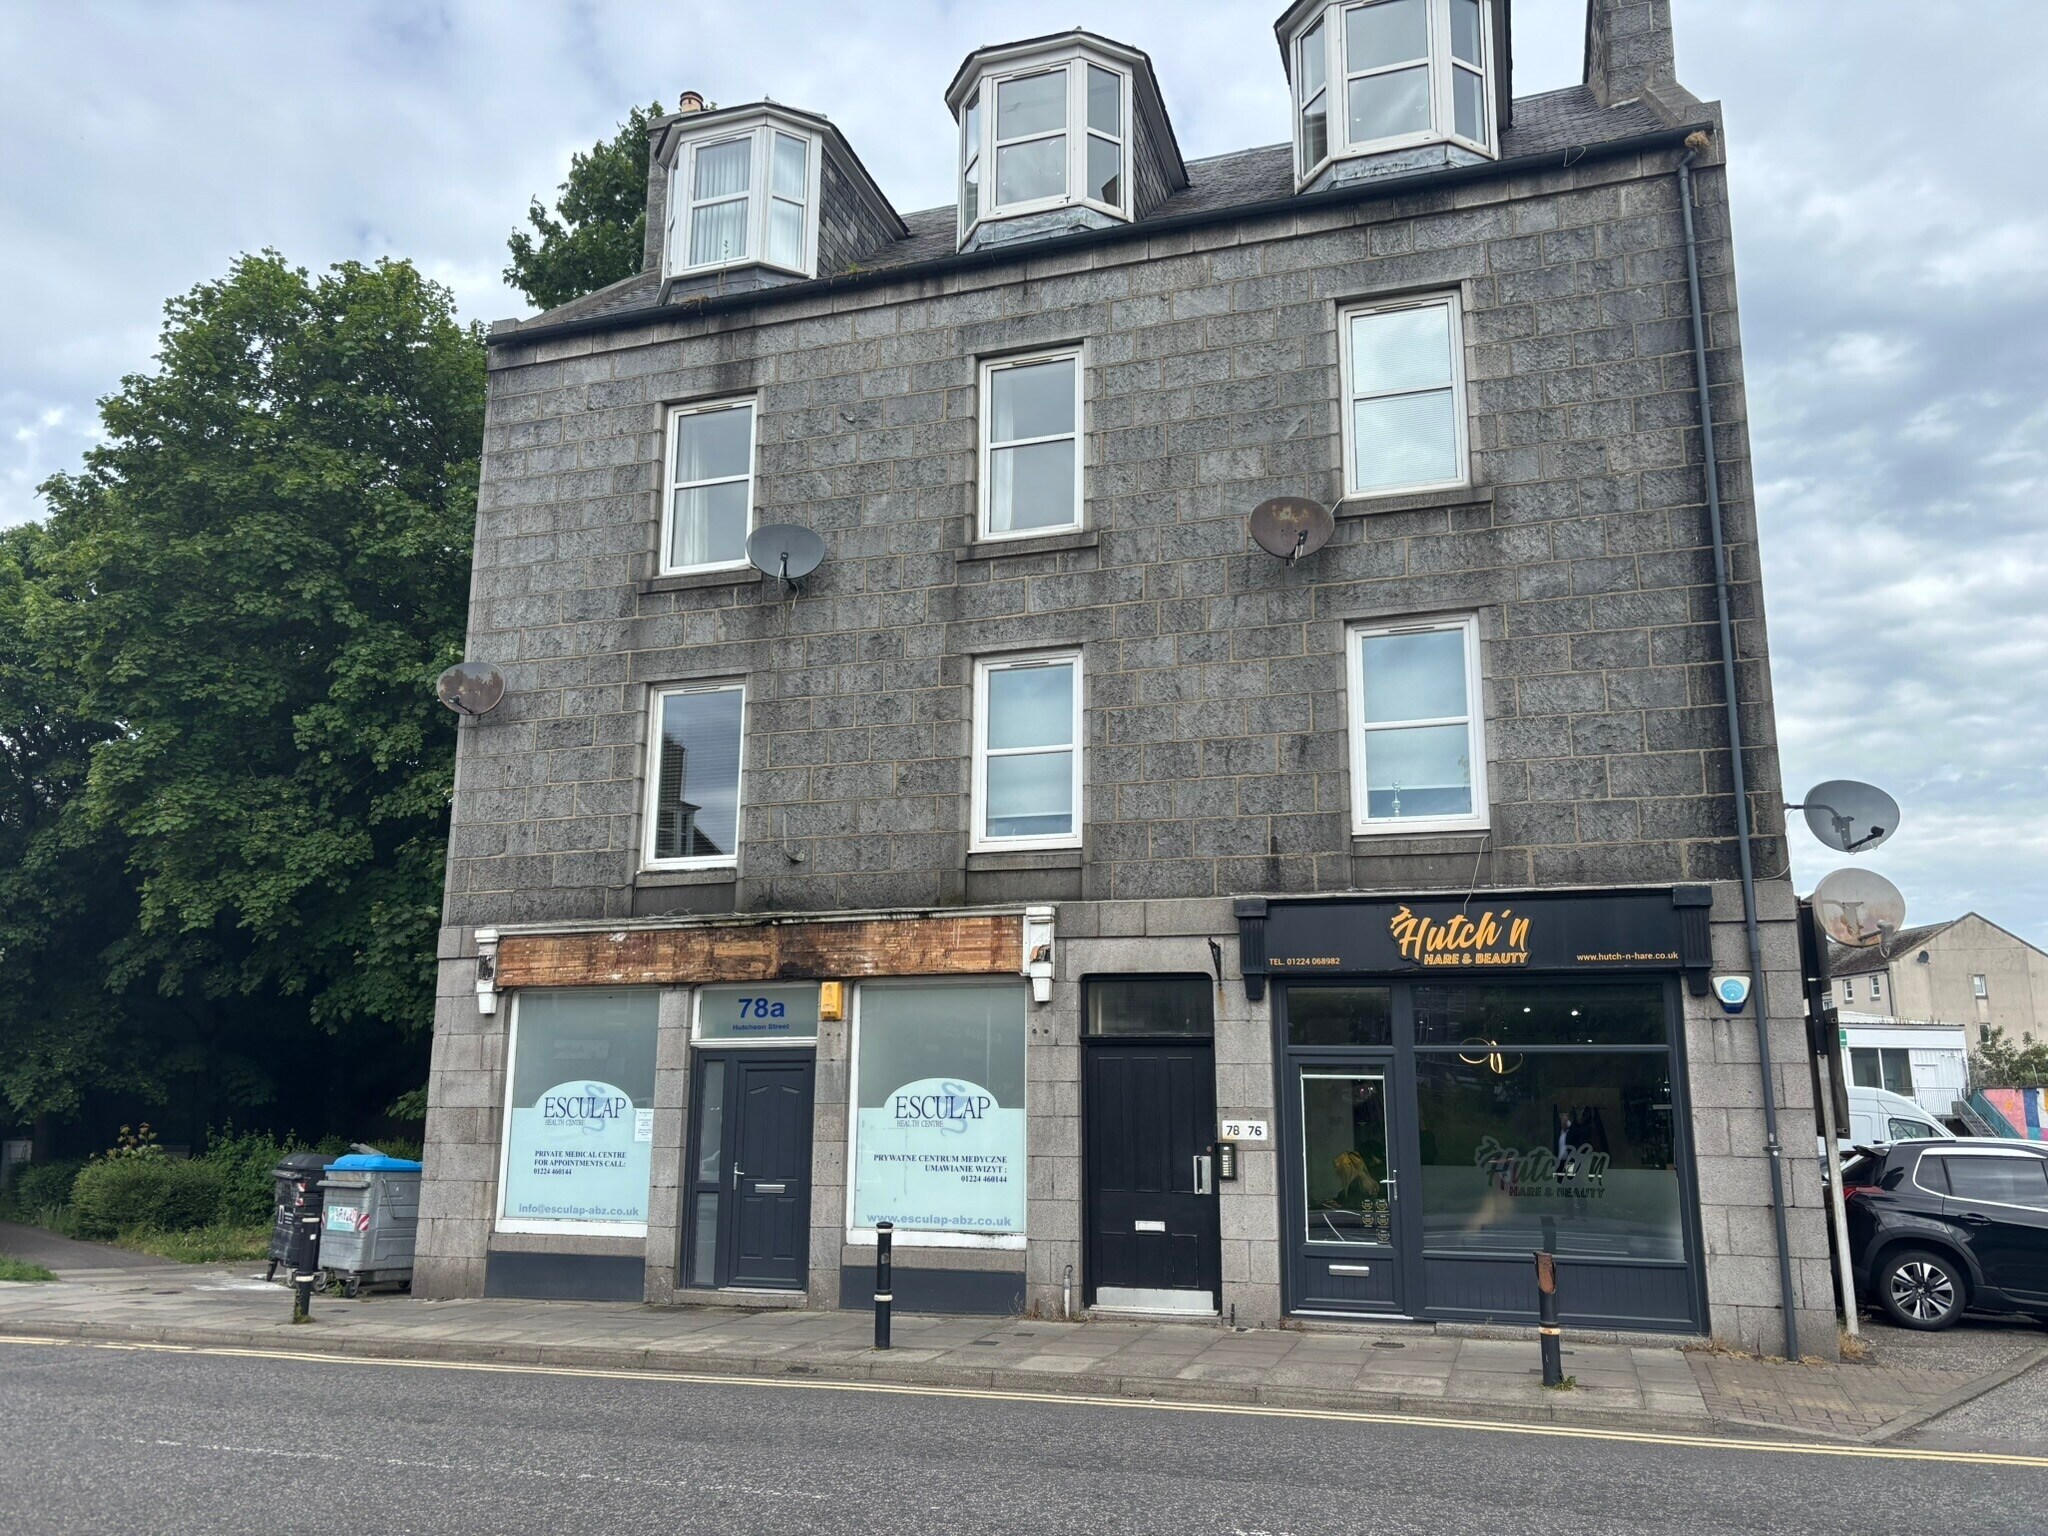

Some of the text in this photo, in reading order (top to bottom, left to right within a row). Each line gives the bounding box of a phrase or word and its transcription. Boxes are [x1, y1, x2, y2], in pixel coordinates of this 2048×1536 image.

[1269, 957, 1341, 966] TEL. 01224 068982
[1424, 952, 1528, 966] HARE & BEAUTY
[1576, 951, 1679, 962] www.hutch-n-hare.co.uk
[738, 997, 785, 1019] 78a
[732, 1023, 767, 1031] Hutcheon
[544, 1096, 627, 1119] ESCULAP
[895, 1095, 991, 1120] ESCULAP
[566, 1119, 586, 1127] CENTRE
[896, 1119, 944, 1128] HEALTH CENTRE
[1226, 1125, 1262, 1137] 78 76
[534, 1150, 627, 1159] PRIVATE MEDICAL CENTRE
[873, 1154, 1008, 1164] PRYWATNE CENTRUM MEDYCZNE
[550, 1159, 603, 1168] APPOINTMENTS
[604, 1160, 626, 1168] CALL:
[925, 1164, 974, 1173] UMAWIANIE
[975, 1165, 1003, 1173] WIZYT
[533, 1167, 551, 1175] 01224
[960, 1175, 1008, 1183] 01224 460144
[1509, 1186, 1542, 1197] HARE
[1556, 1186, 1606, 1199] BEAUTY
[518, 1203, 639, 1217] info@esculap-abz.co.uk
[867, 1213, 1012, 1227] www.esculap-abz.co.uk
